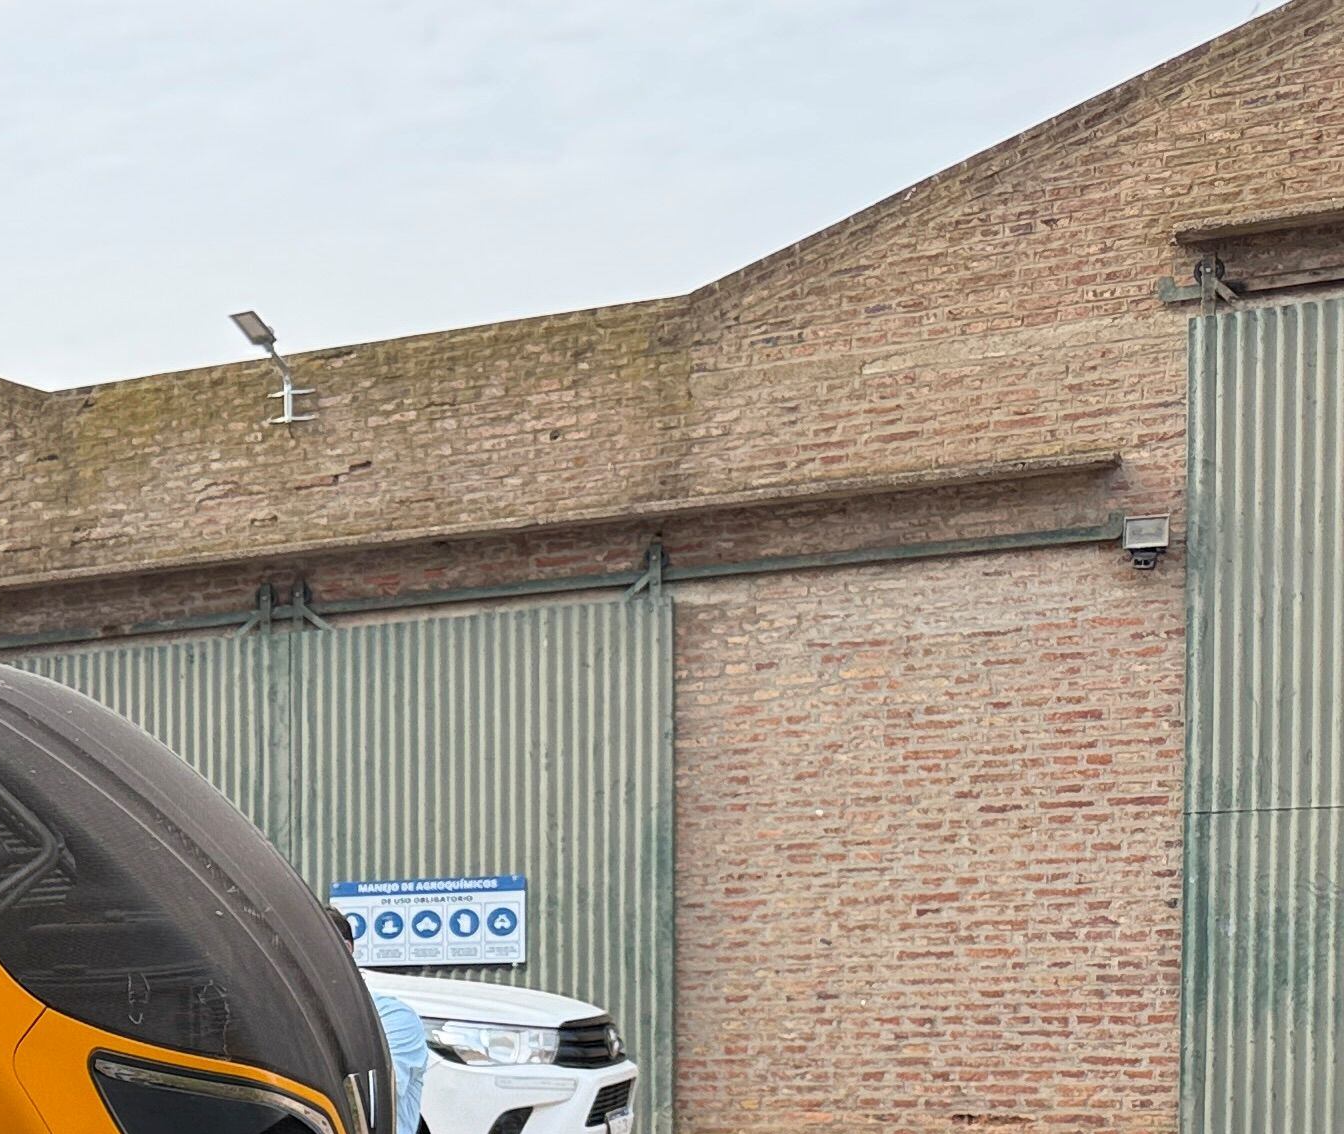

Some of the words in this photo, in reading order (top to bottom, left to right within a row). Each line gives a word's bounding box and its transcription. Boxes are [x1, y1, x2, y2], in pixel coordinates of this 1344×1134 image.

[357, 882, 400, 894] MANEJO
[401, 882, 414, 892] DE
[415, 878, 498, 891] AGROQUÍMICOS
[413, 895, 474, 903] OBLIGATORIO
